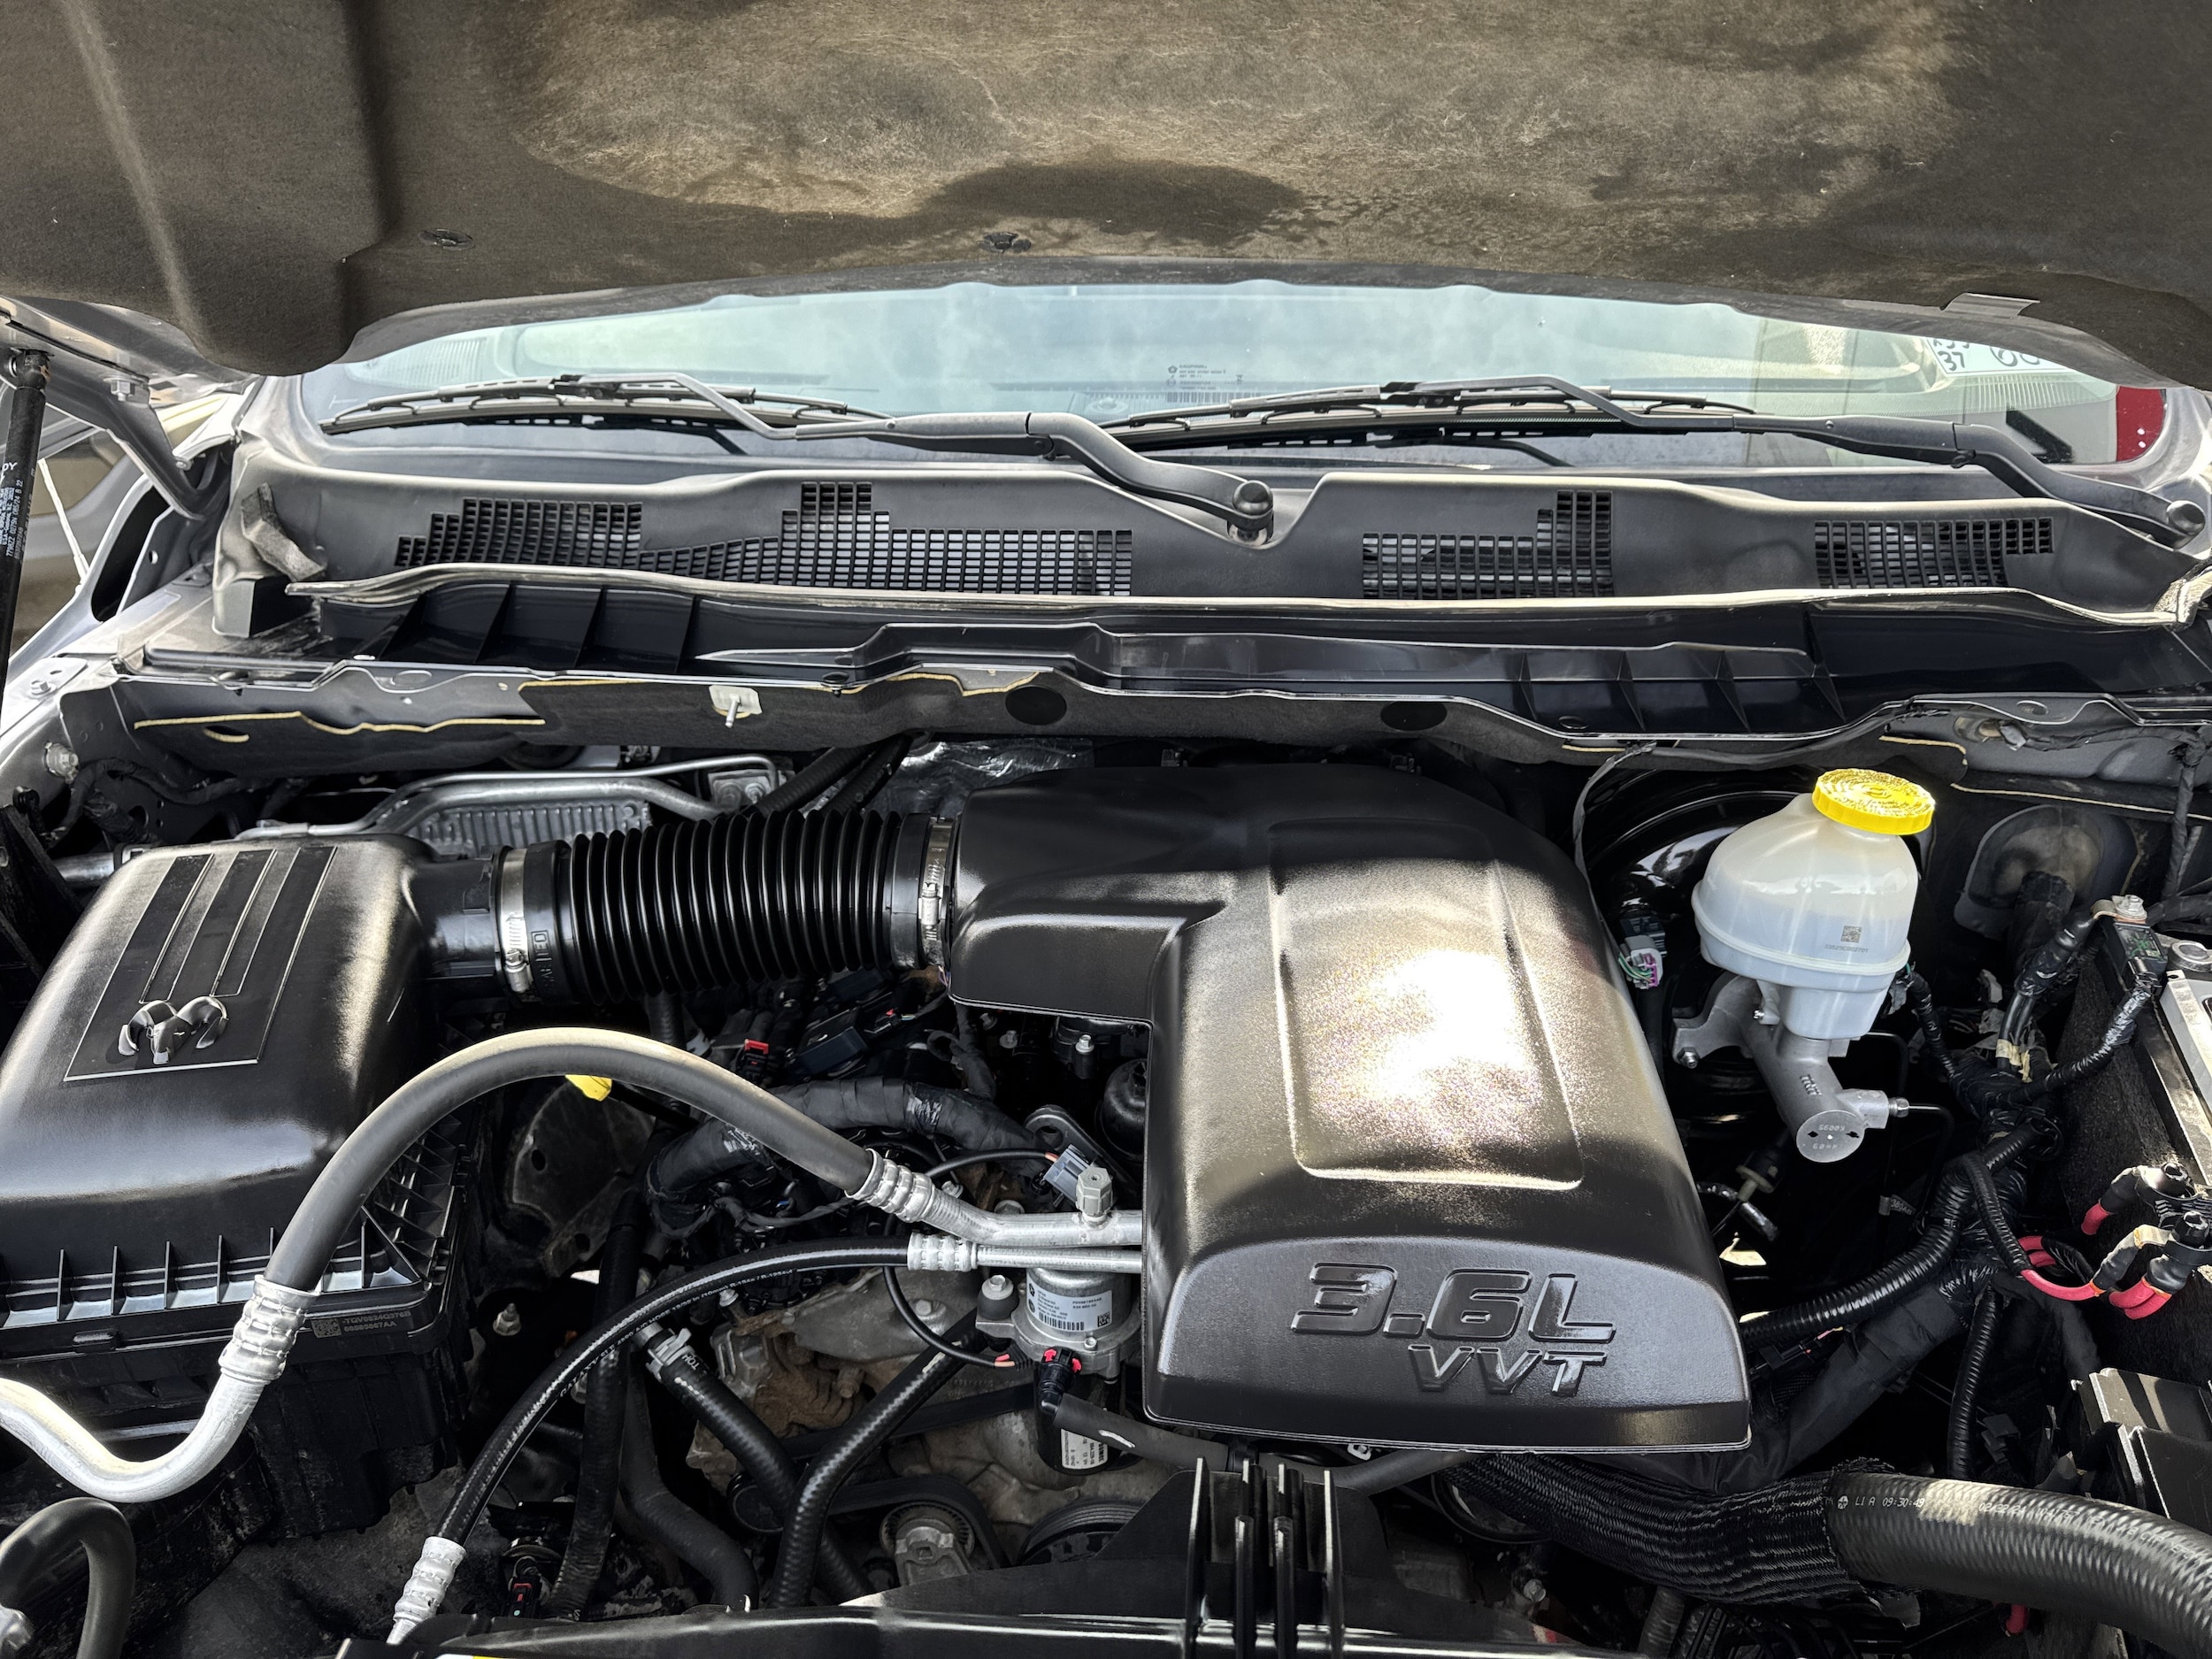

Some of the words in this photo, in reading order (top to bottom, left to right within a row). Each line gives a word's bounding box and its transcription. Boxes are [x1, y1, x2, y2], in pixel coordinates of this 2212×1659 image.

[1937, 350, 1965, 372] 37
[1291, 1262, 1617, 1344] 3.6L
[1408, 1344, 1607, 1397] VVT
[1882, 1497, 1925, 1508] 09:30:49
